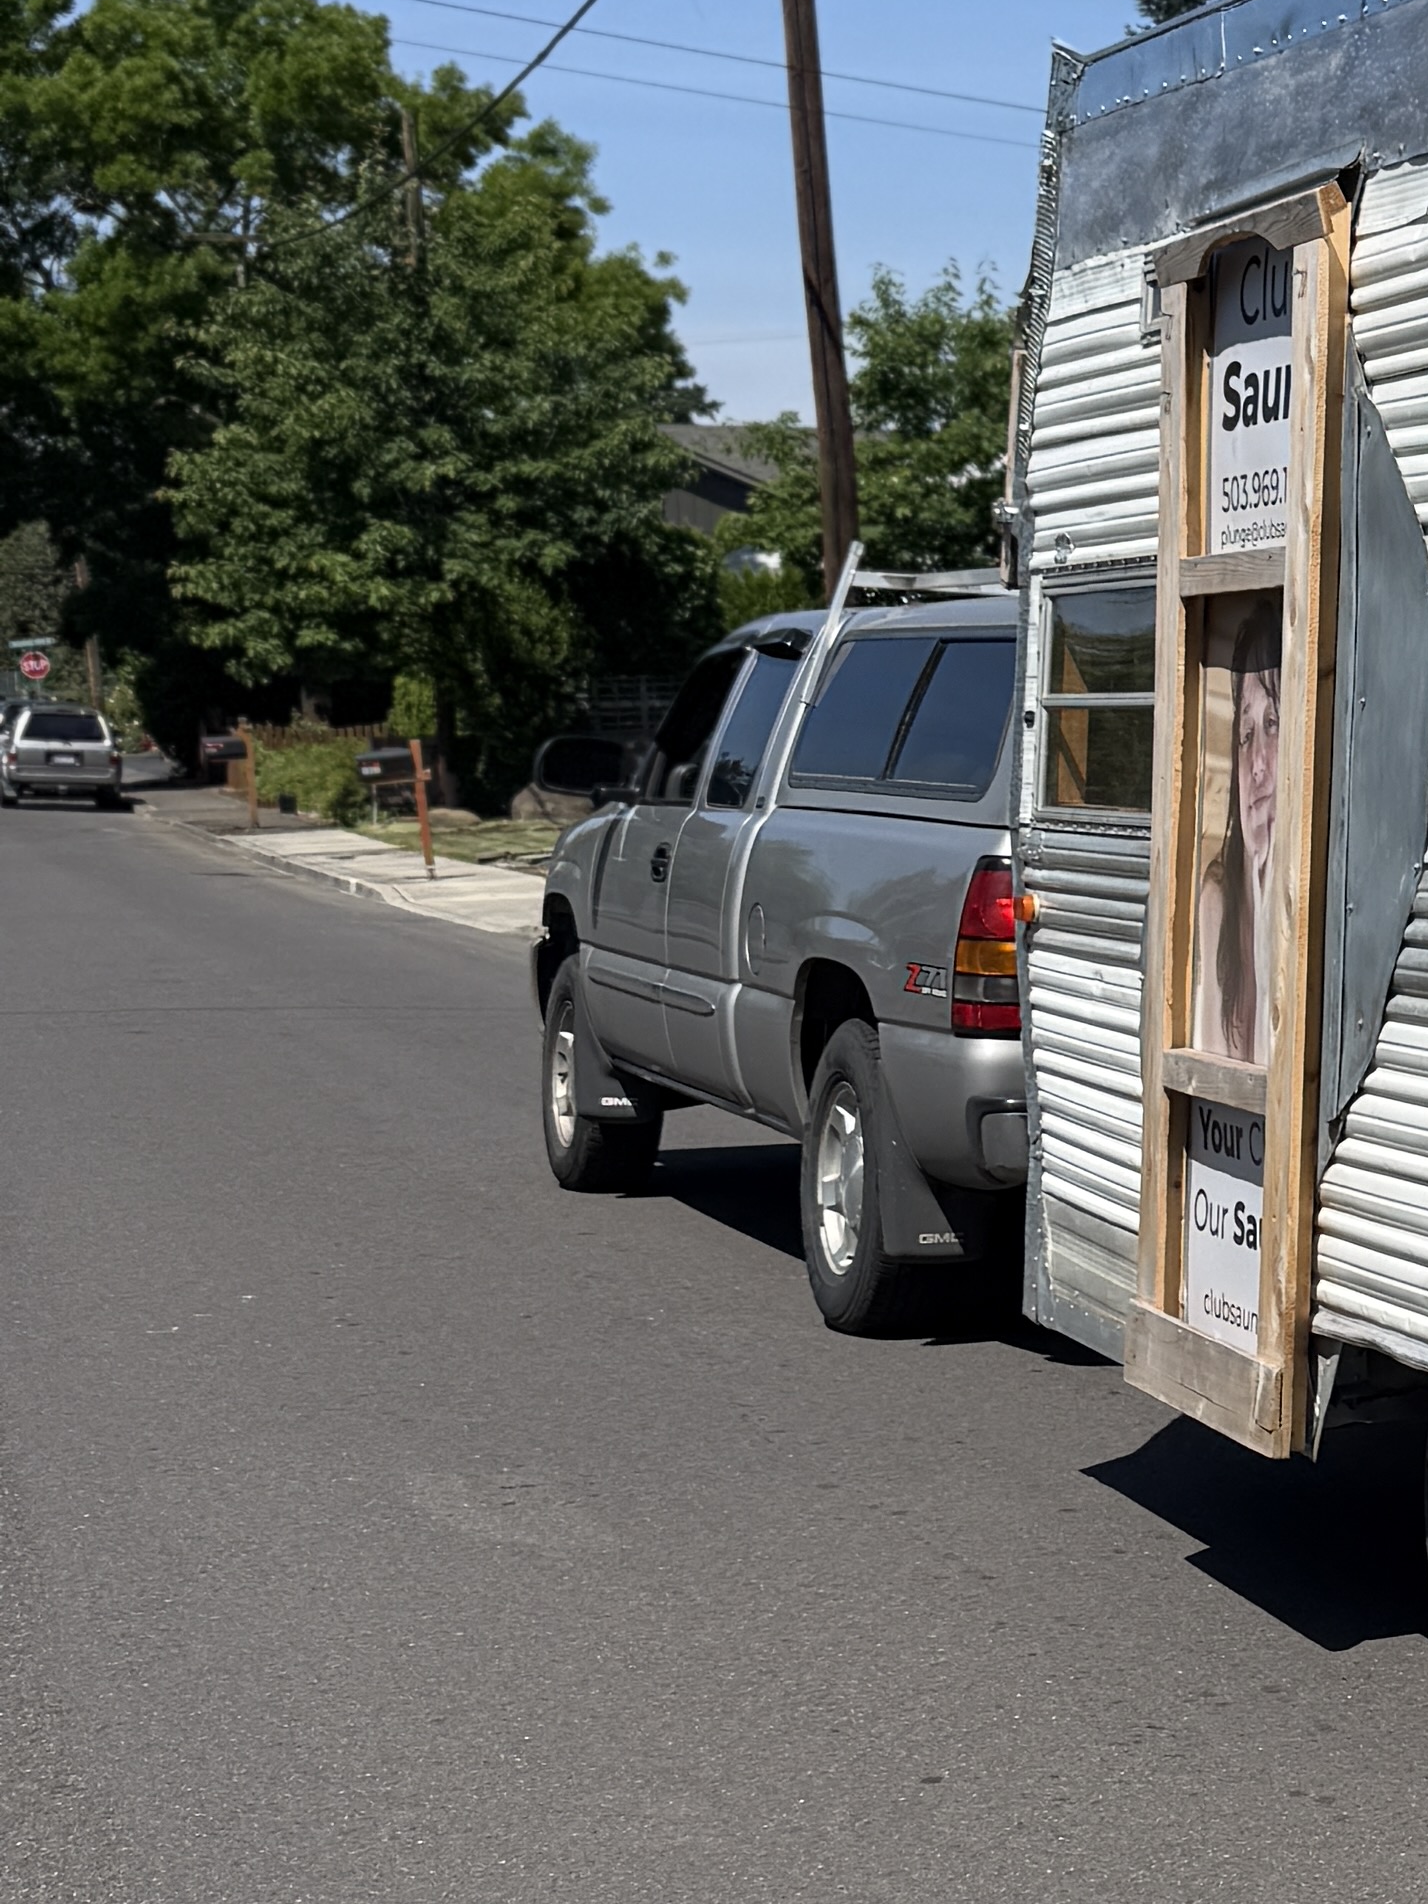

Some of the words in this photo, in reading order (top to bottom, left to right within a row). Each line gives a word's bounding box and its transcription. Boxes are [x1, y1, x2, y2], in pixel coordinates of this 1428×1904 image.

[904, 962, 948, 994] Z71
[1199, 1105, 1243, 1160] Your
[1194, 1188, 1229, 1239] Our
[1233, 1201, 1262, 1250] Sa
